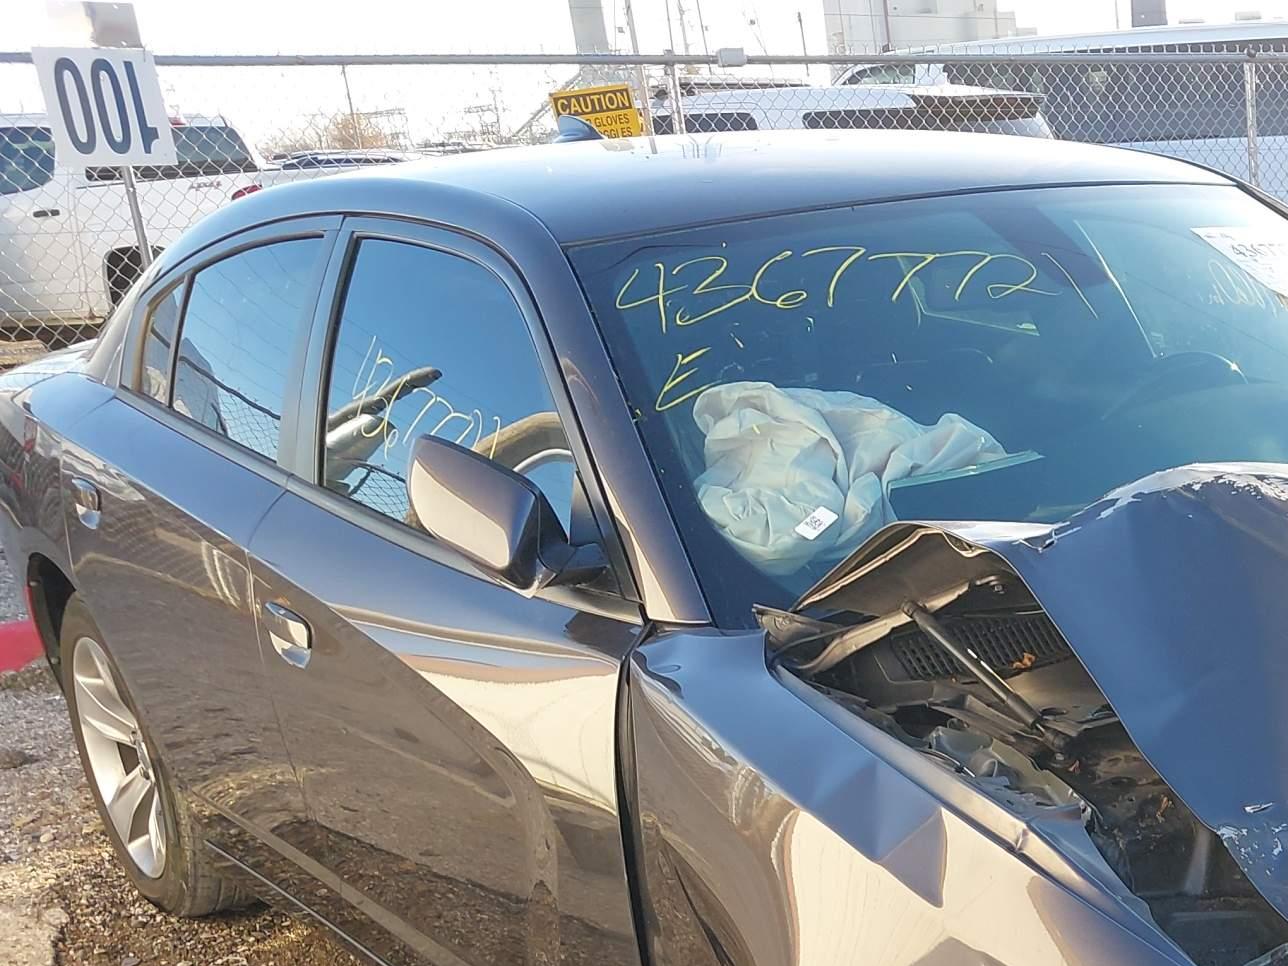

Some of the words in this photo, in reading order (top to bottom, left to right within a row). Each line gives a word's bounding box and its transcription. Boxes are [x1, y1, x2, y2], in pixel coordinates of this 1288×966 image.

[54, 57, 159, 155] 100
[557, 91, 630, 115] CAUTION
[595, 113, 631, 128] GLOVES
